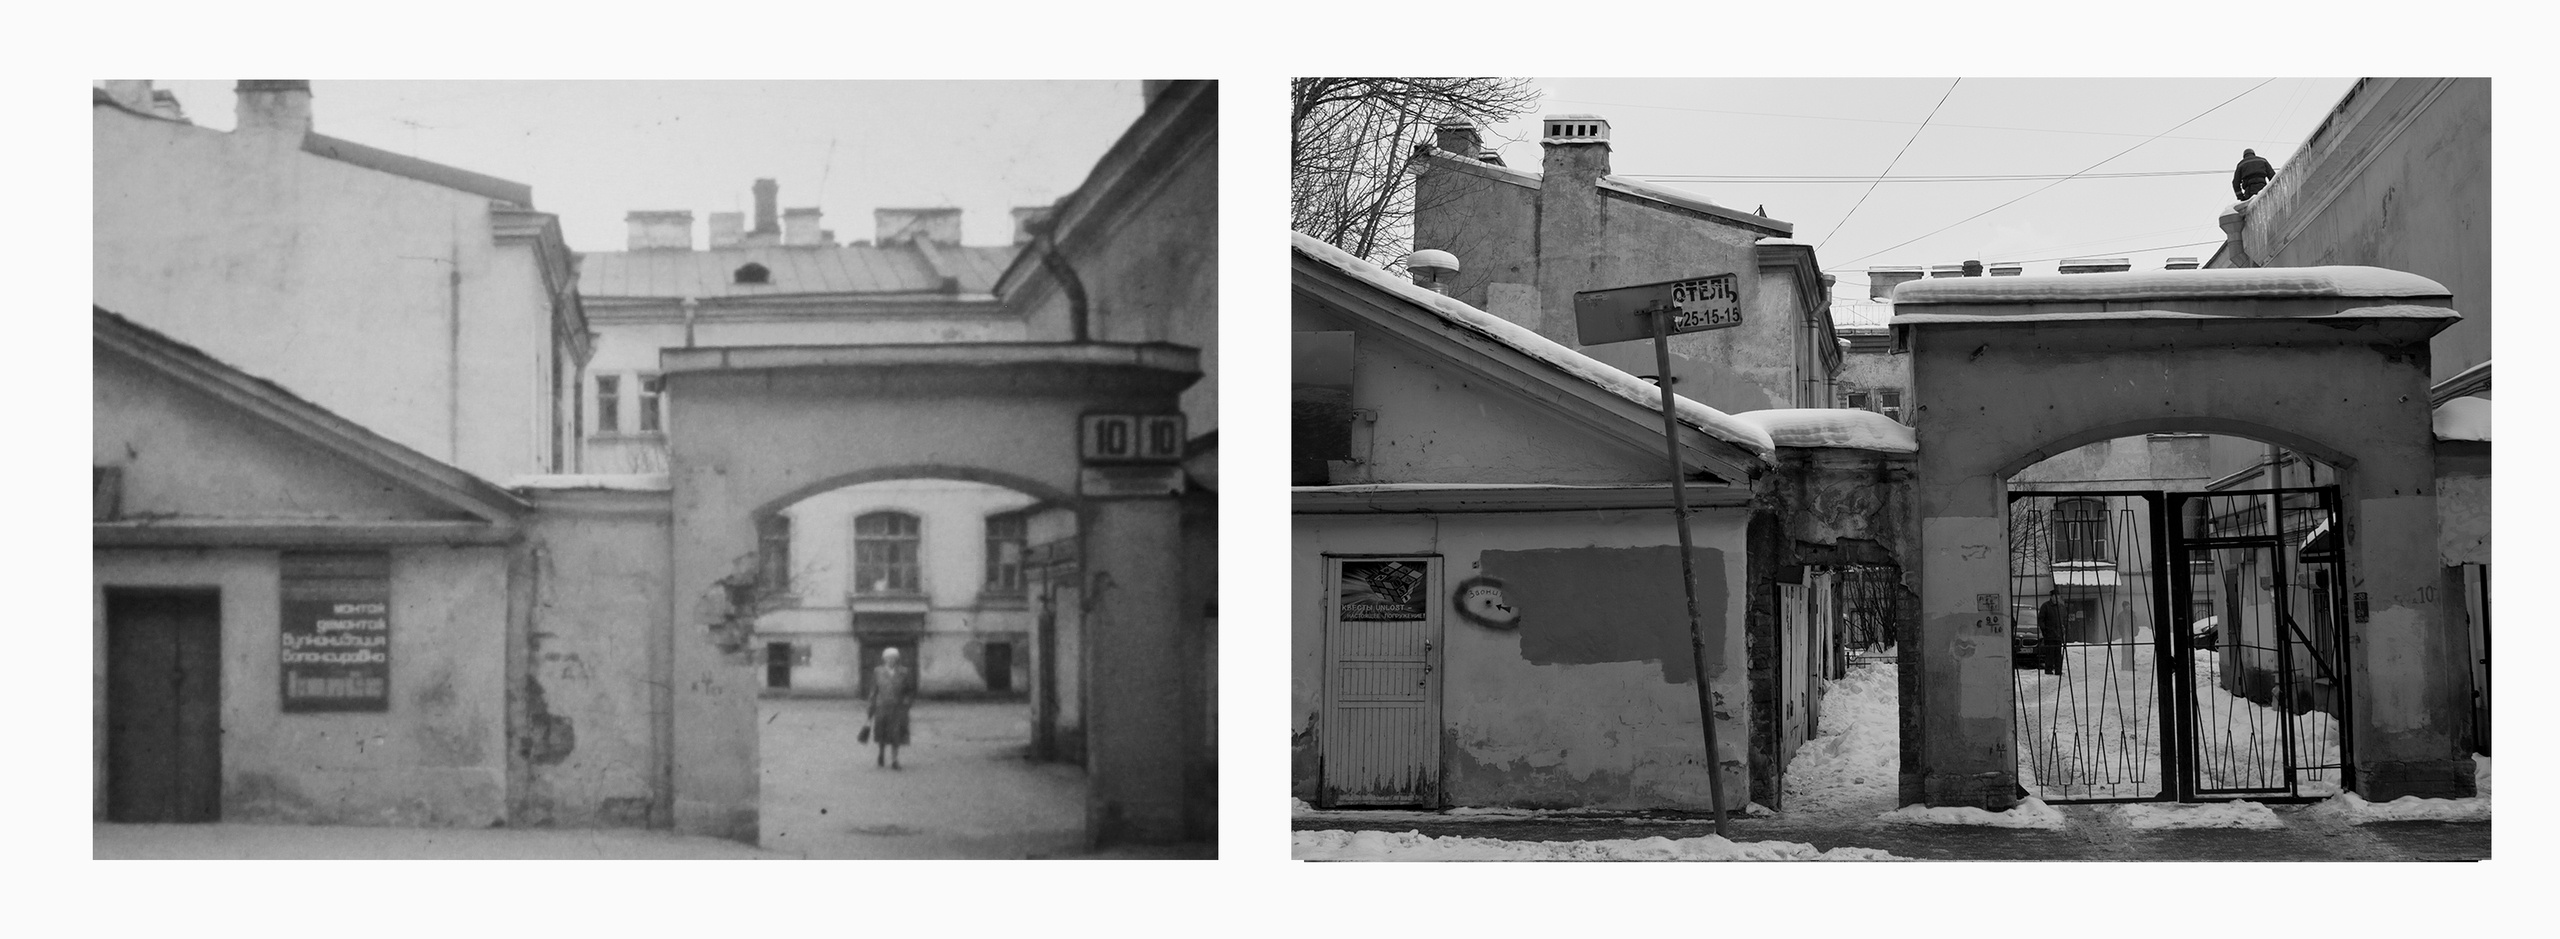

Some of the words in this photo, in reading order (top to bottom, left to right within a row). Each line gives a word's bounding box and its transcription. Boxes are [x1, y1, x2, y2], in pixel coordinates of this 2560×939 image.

[1673, 278, 1737, 303] ОТЕЛЬ
[1096, 419, 1127, 454] 10
[1150, 420, 1175, 454] 10
